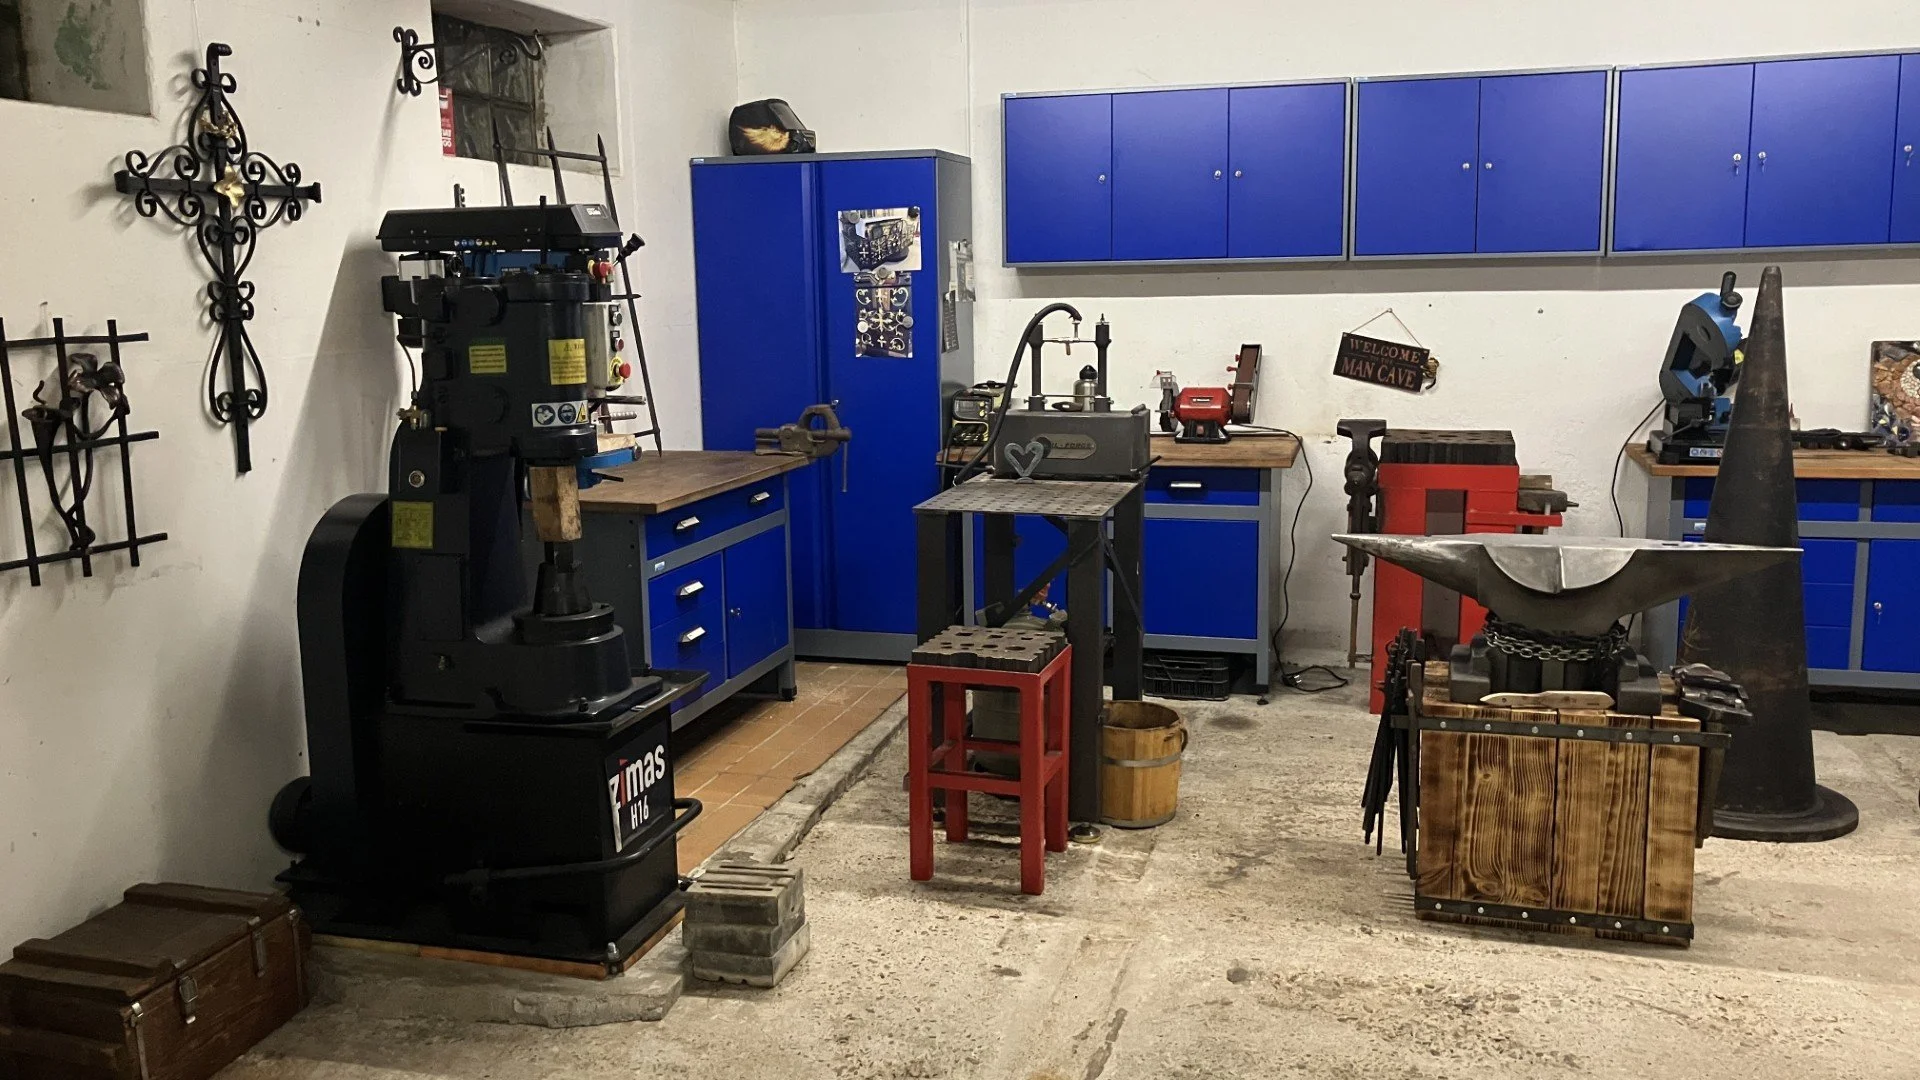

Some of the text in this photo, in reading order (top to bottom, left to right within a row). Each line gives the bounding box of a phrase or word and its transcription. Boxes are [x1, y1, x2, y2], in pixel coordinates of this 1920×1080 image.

[1350, 338, 1420, 363] WELCOME
[1341, 357, 1375, 378] MAN
[1377, 365, 1416, 388] CAVE
[630, 794, 649, 830] H16
